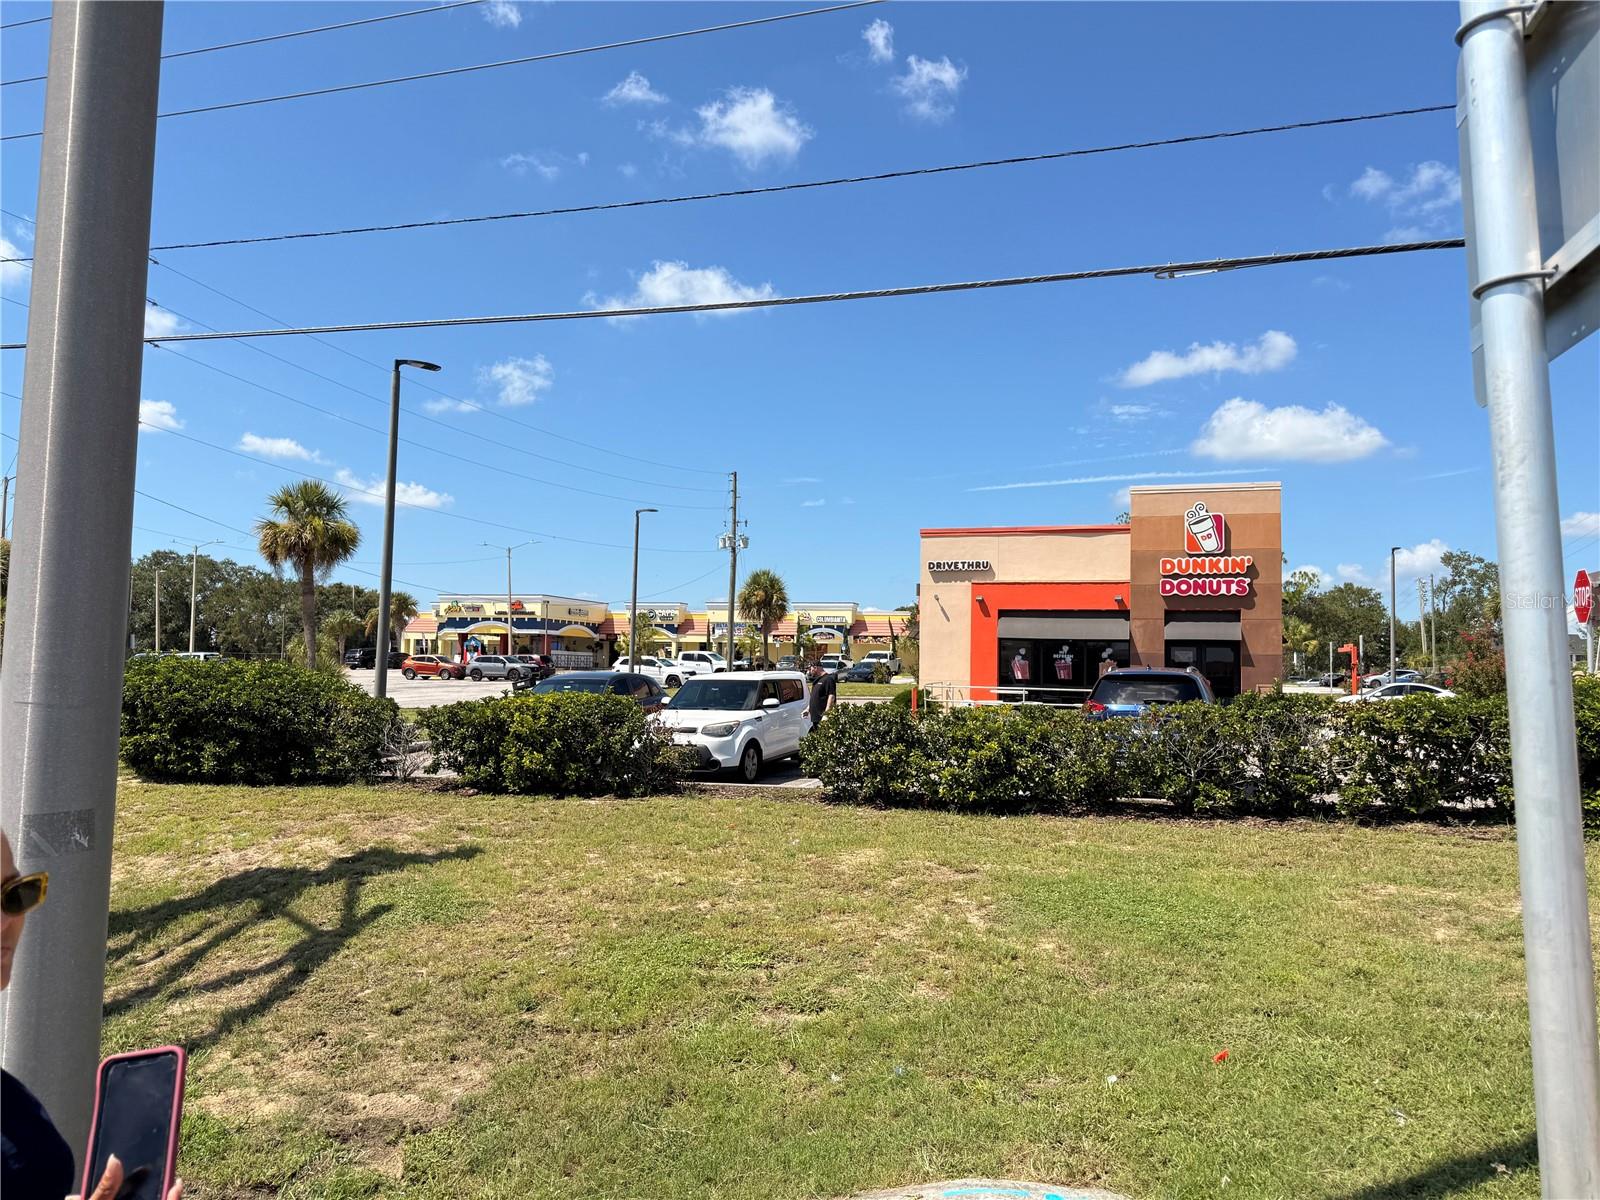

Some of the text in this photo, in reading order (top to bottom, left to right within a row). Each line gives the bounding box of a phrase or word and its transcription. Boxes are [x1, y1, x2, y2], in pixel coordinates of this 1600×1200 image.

[1200, 533, 1213, 541] DD
[1160, 556, 1253, 574] DUNKIN'
[1160, 578, 1249, 596] DONUTS
[1574, 586, 1590, 607] STOP
